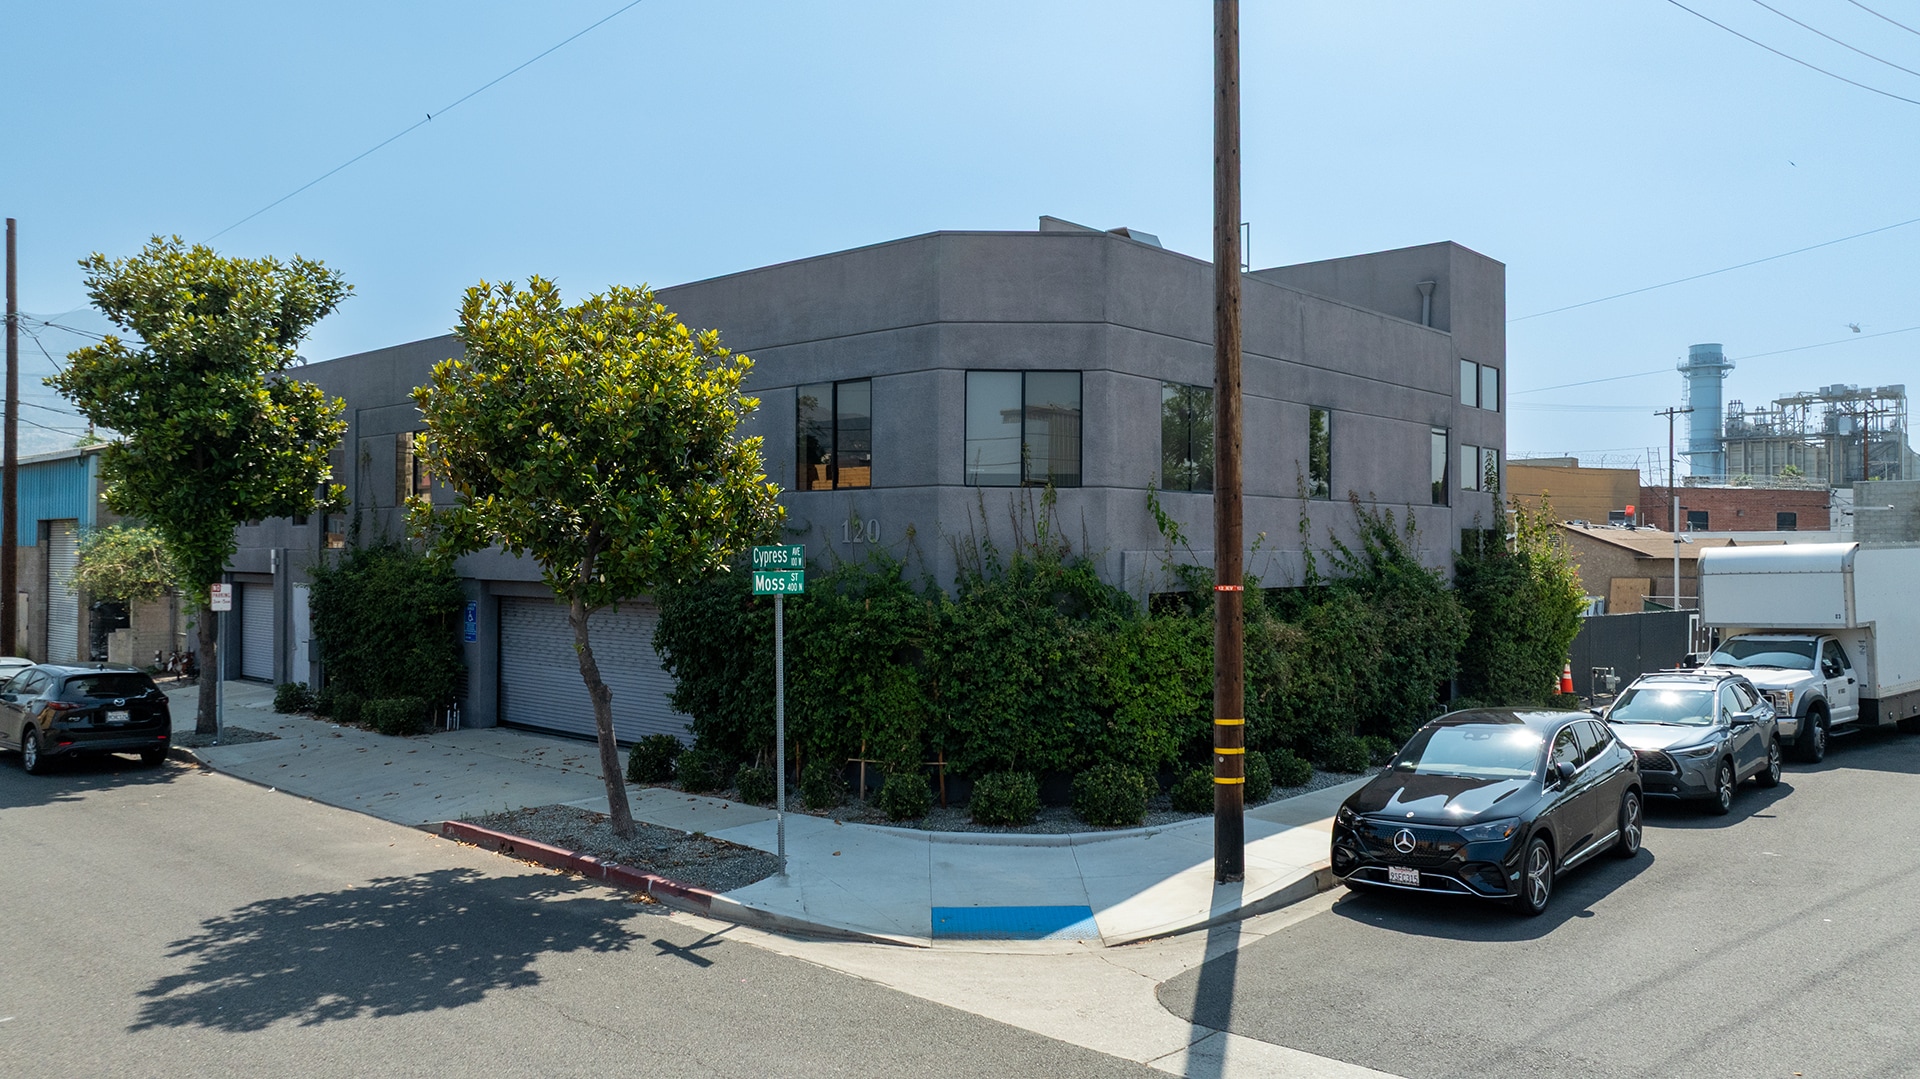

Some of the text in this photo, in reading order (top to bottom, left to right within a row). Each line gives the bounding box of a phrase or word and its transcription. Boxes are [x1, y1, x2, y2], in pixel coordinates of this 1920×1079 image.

[841, 519, 881, 544] 120
[753, 547, 800, 568] Cypress AVE
[755, 572, 798, 591] Moss ST
[787, 582, 798, 591] 400
